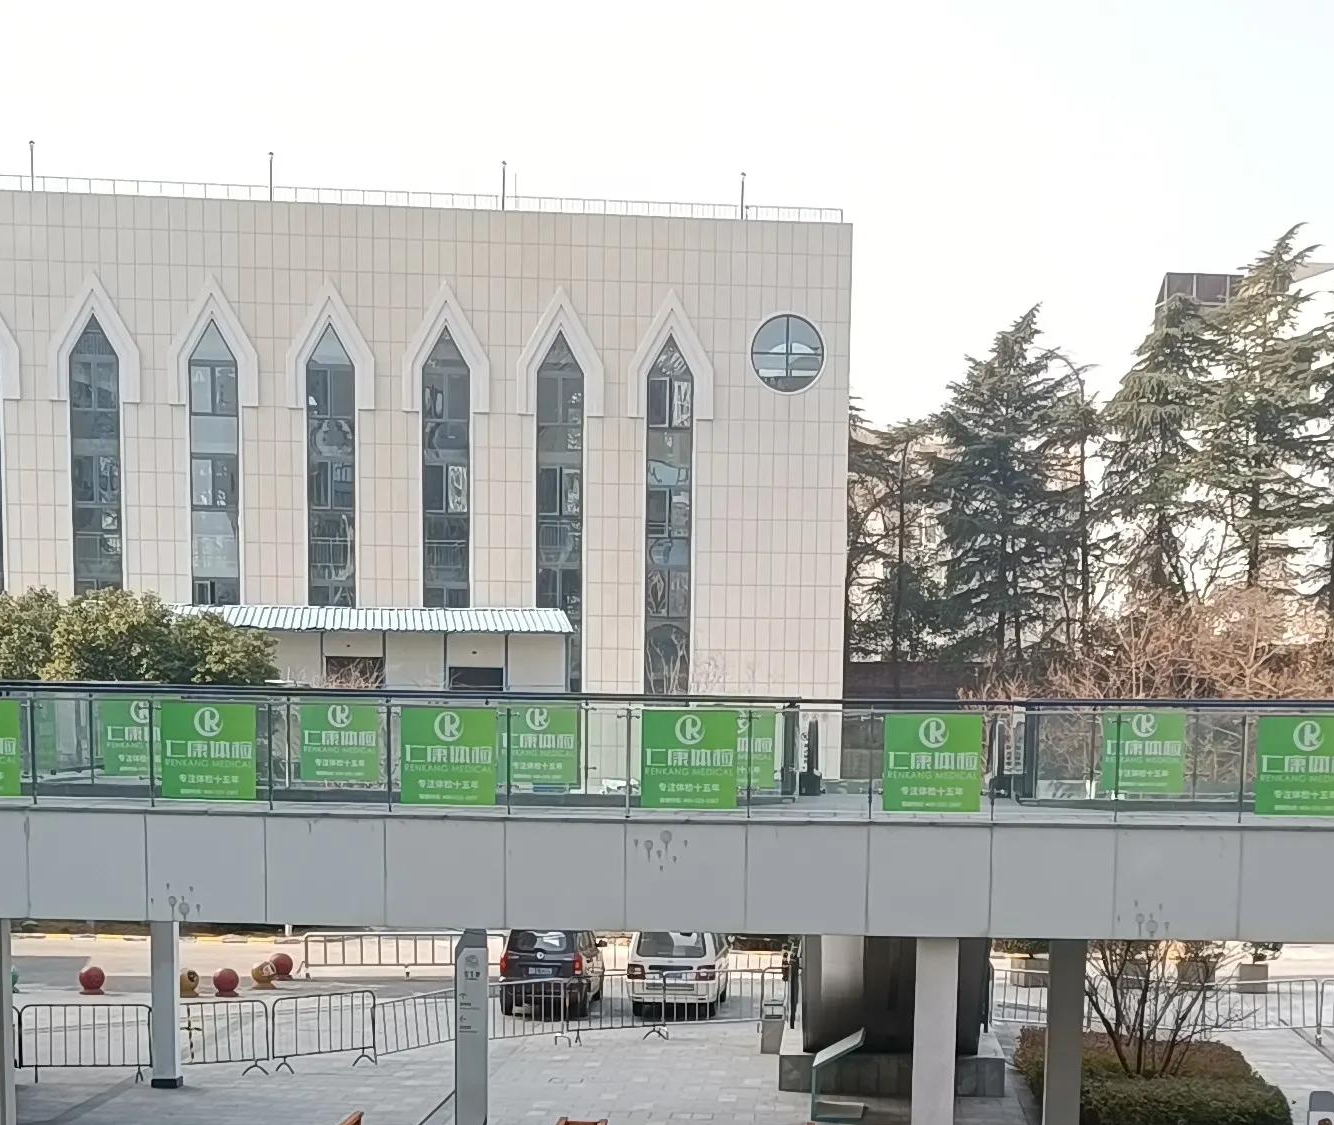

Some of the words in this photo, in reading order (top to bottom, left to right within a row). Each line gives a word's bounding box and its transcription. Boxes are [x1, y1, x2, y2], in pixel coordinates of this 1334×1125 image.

[646, 749, 734, 767] 仁康体检
[888, 752, 978, 770] 仁康体检
